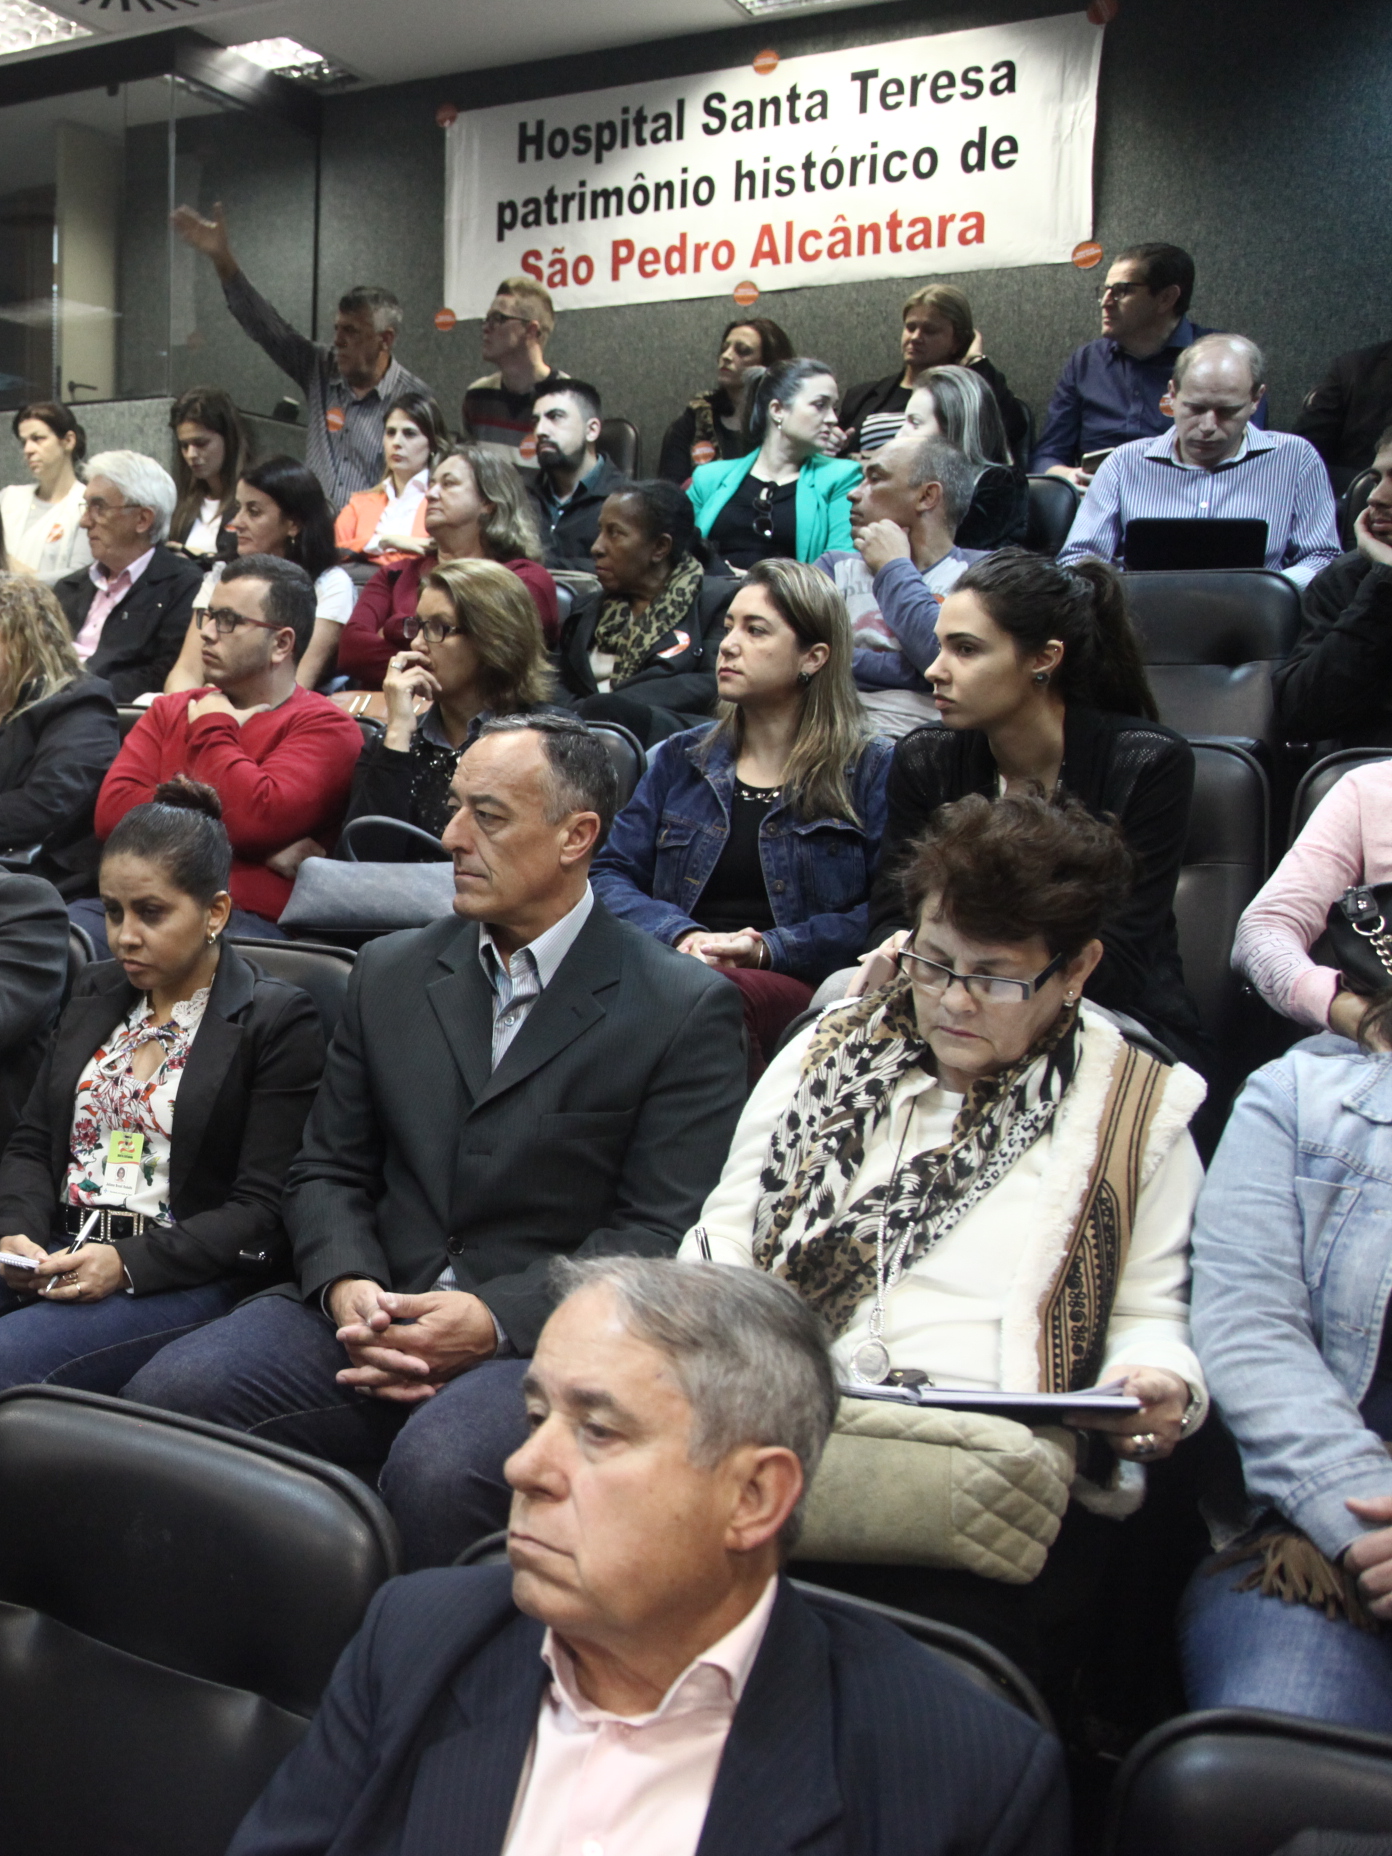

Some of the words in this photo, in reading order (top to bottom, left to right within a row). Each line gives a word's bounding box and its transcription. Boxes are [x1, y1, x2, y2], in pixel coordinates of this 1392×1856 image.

[517, 98, 686, 165] Hospital
[701, 83, 829, 137] Santa
[850, 59, 1017, 115] Teresa
[497, 167, 716, 243] patrimônio
[734, 141, 939, 202] histórico
[960, 126, 1019, 175] de
[520, 246, 595, 289] São
[610, 232, 736, 282] Pedro
[749, 208, 985, 268] Alcântara
